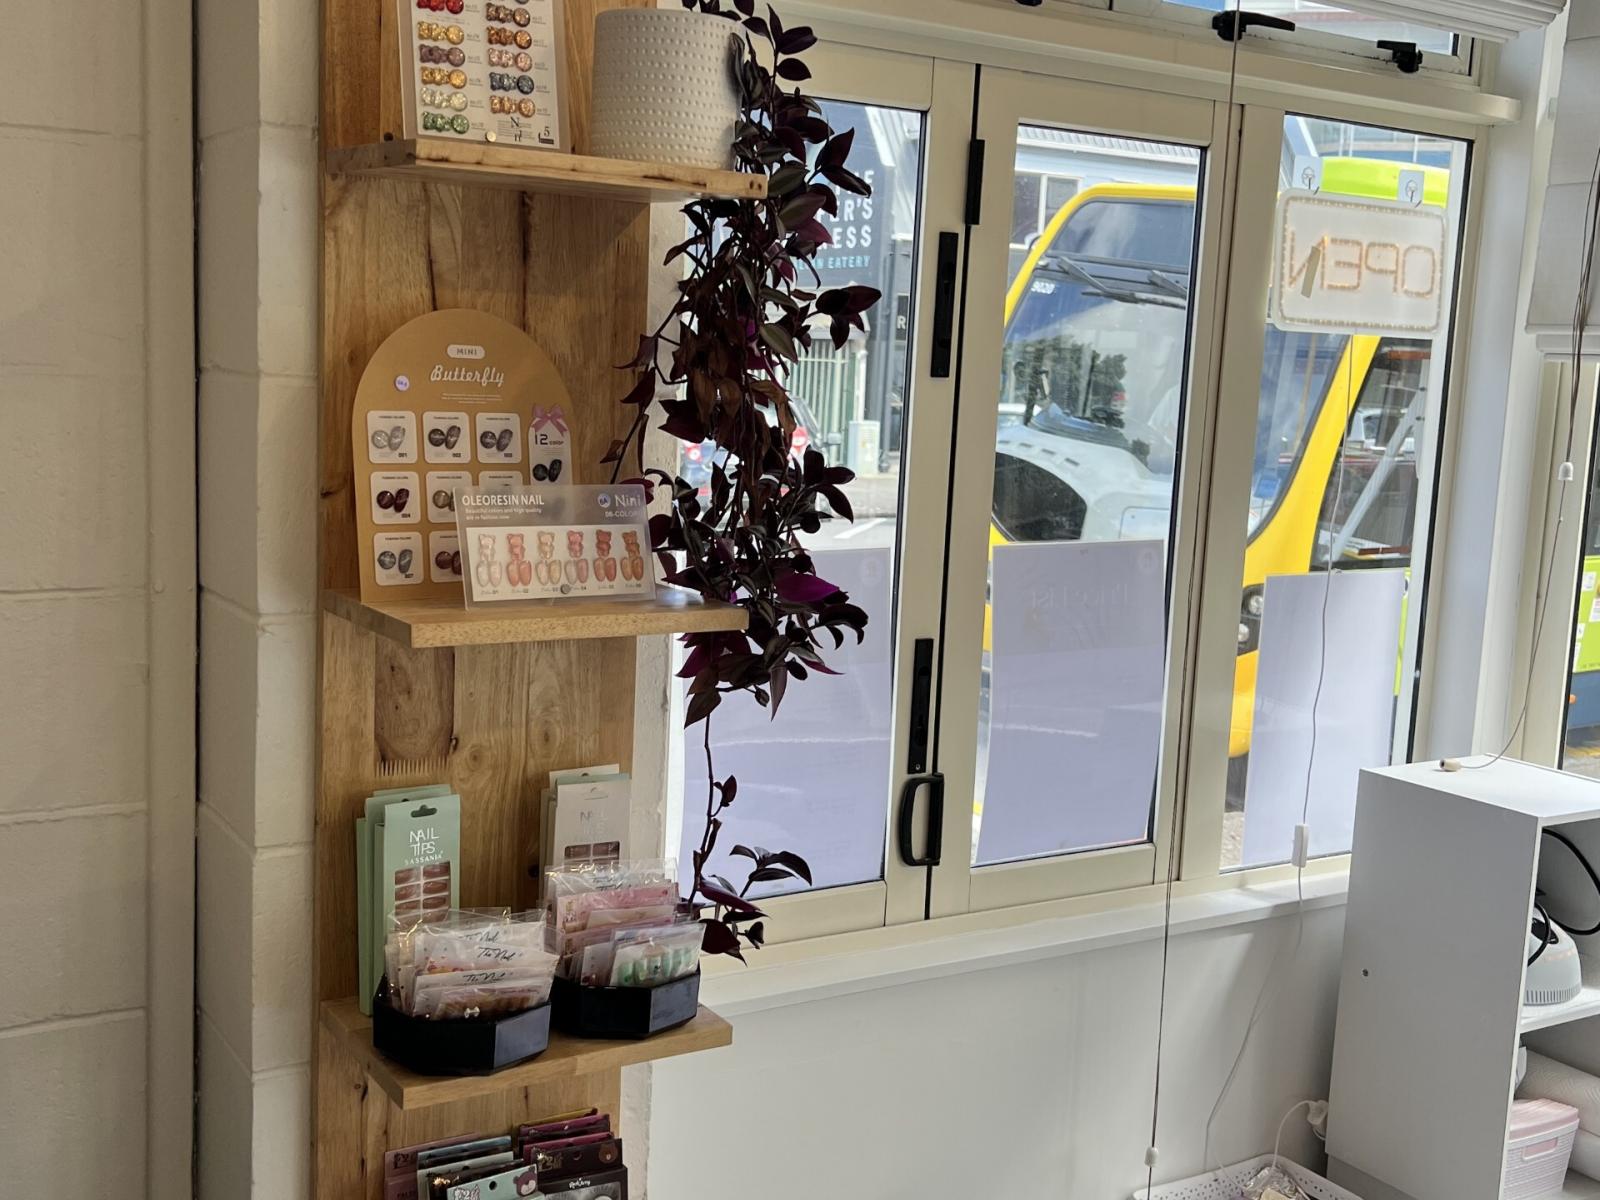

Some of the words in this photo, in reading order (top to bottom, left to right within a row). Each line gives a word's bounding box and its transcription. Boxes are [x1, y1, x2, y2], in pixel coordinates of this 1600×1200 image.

[828, 255, 870, 269] EATERY
[456, 346, 477, 356] MINI
[430, 365, 505, 387] Butterfly
[535, 433, 548, 445] 12
[461, 494, 519, 506] OLEORESIN
[520, 494, 545, 505] NAIL
[409, 827, 440, 843] NAIL
[410, 841, 436, 857] TIPS
